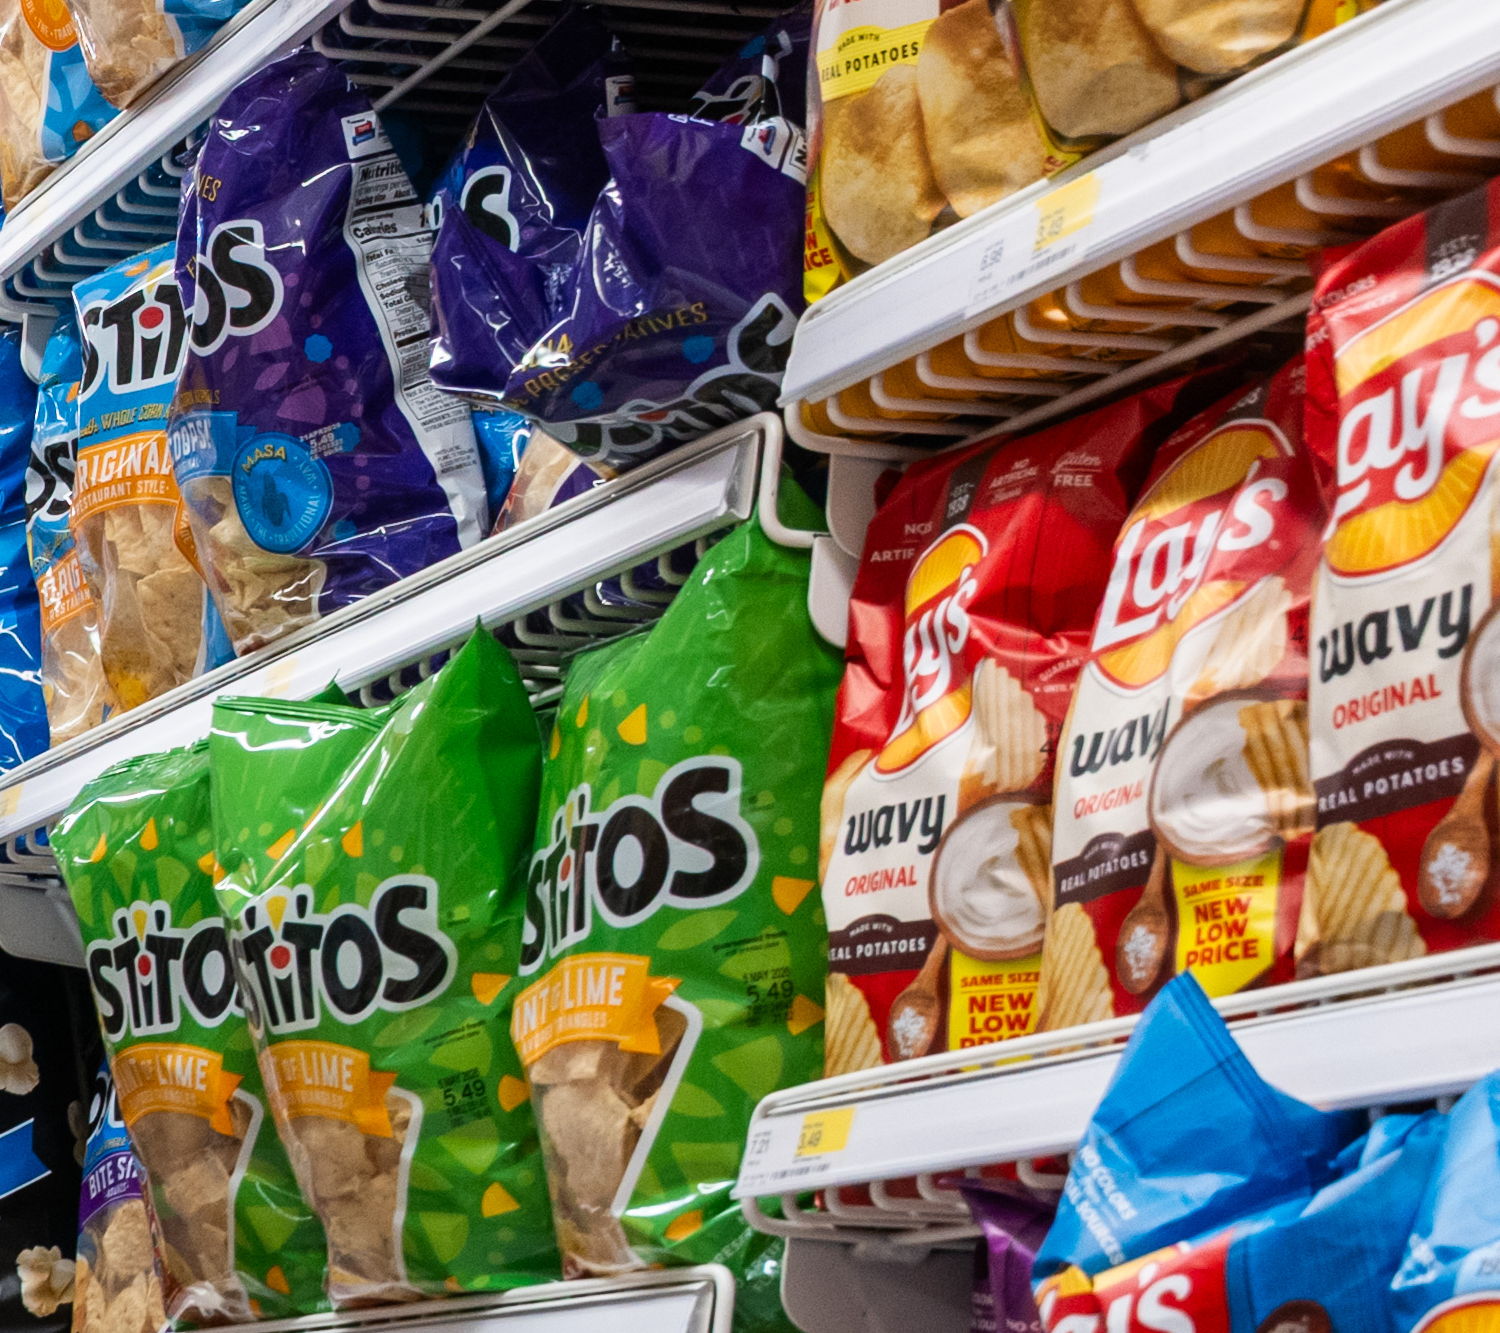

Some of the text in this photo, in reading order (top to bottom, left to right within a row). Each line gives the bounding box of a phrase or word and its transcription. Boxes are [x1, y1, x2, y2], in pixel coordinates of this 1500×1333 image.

[845, 40, 921, 77] POTATOES
[1053, 475, 1093, 486] FREE
[1092, 460, 1288, 651] Lay's
[1317, 583, 1474, 682] wavy
[1331, 673, 1442, 730] ORIGINAL
[1317, 754, 1466, 813] REAL POTATOES
[843, 792, 949, 856] wavy
[844, 865, 918, 898] ORIGINAL
[1193, 898, 1252, 926] NEW
[854, 936, 927, 959] POTATOES
[1195, 919, 1249, 946] LOW
[1185, 939, 1260, 969] PRICE
[564, 966, 627, 1009] LIME
[967, 993, 1033, 1014] NEW
[968, 1012, 1030, 1034] LOW
